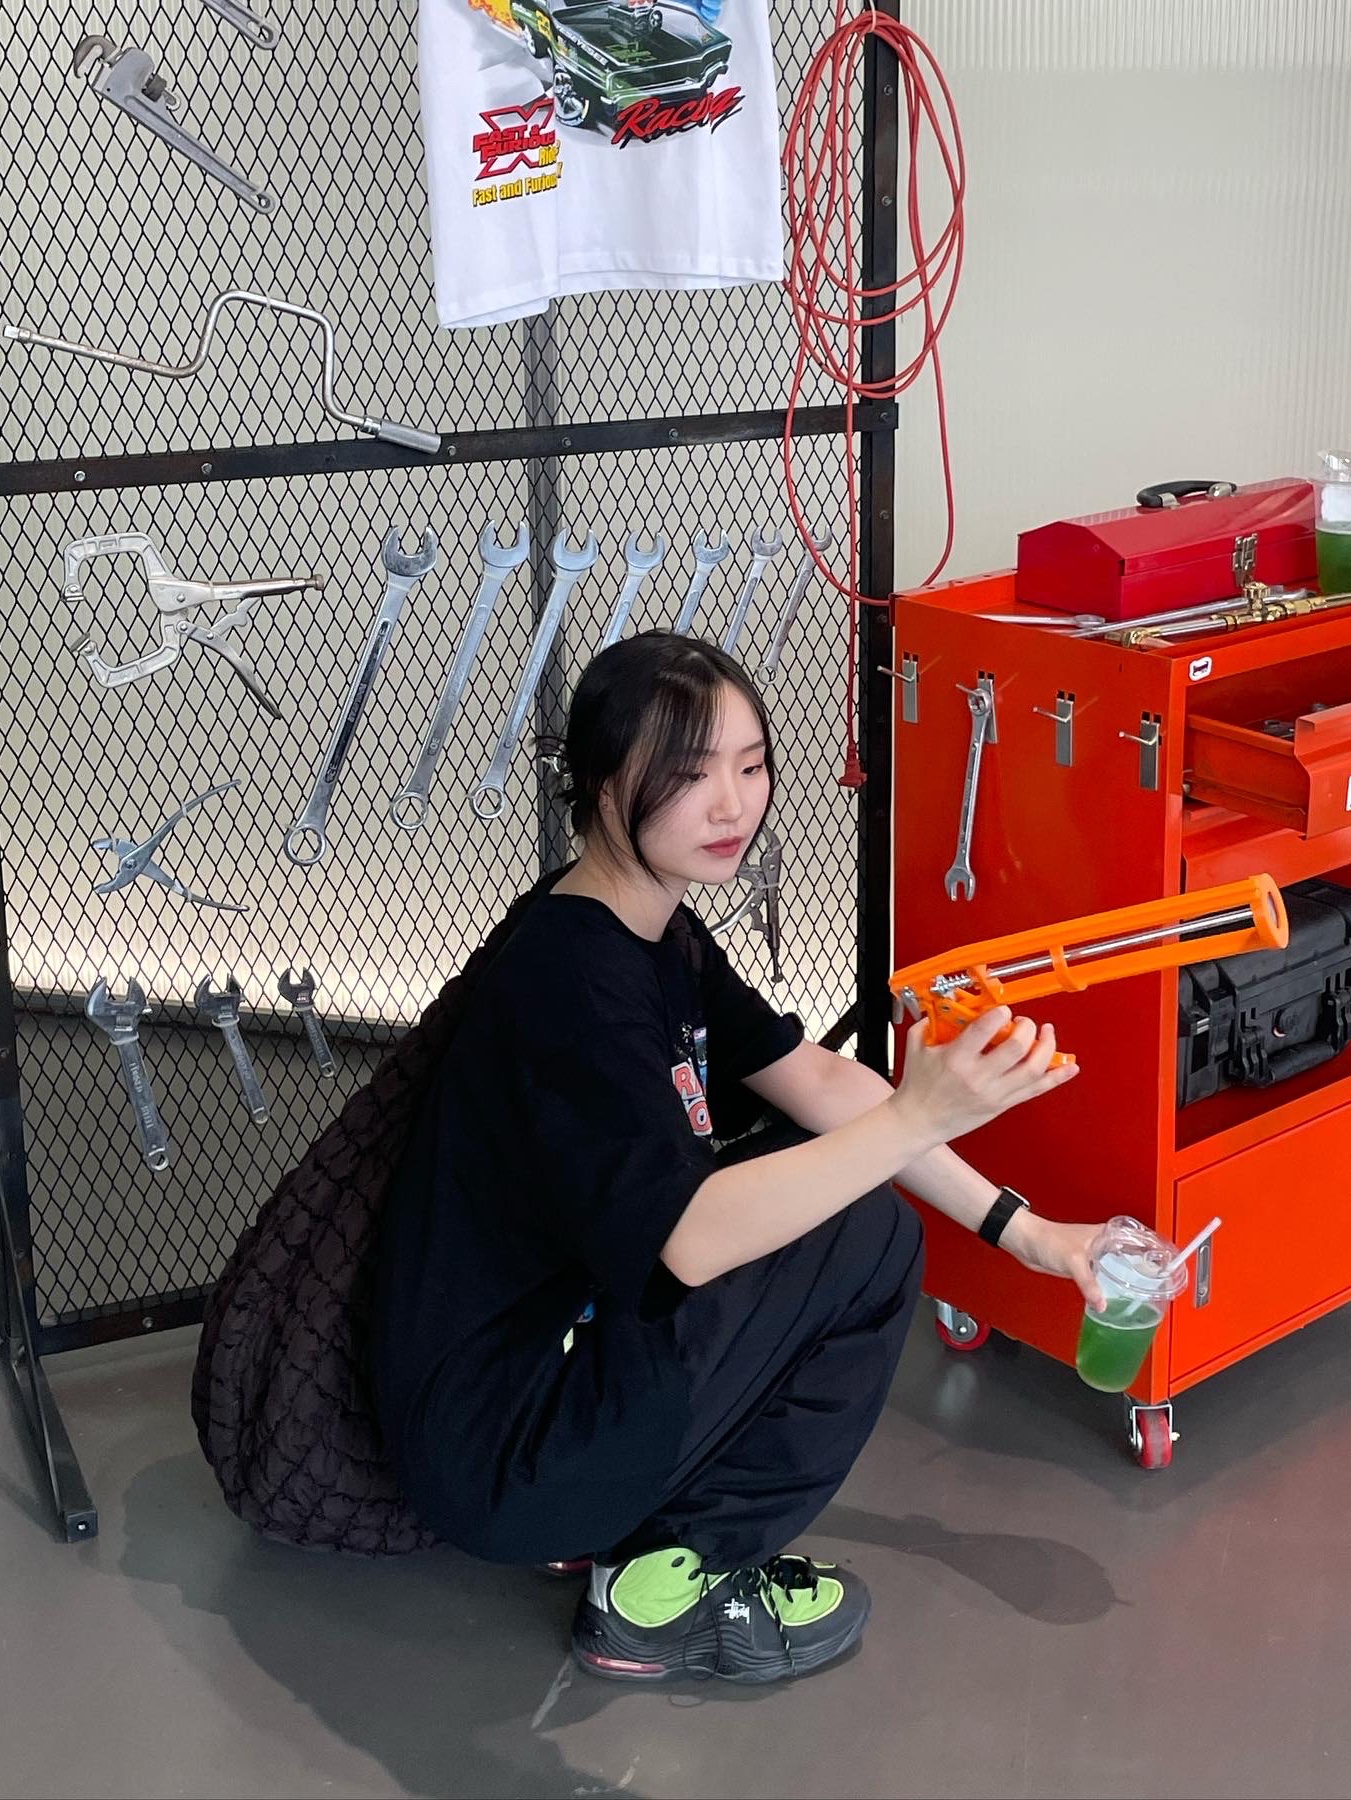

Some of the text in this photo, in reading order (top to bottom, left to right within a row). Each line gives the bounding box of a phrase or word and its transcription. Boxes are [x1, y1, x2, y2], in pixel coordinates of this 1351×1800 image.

[473, 125, 528, 153] FAST
[473, 165, 562, 207] Fast and Furiou
